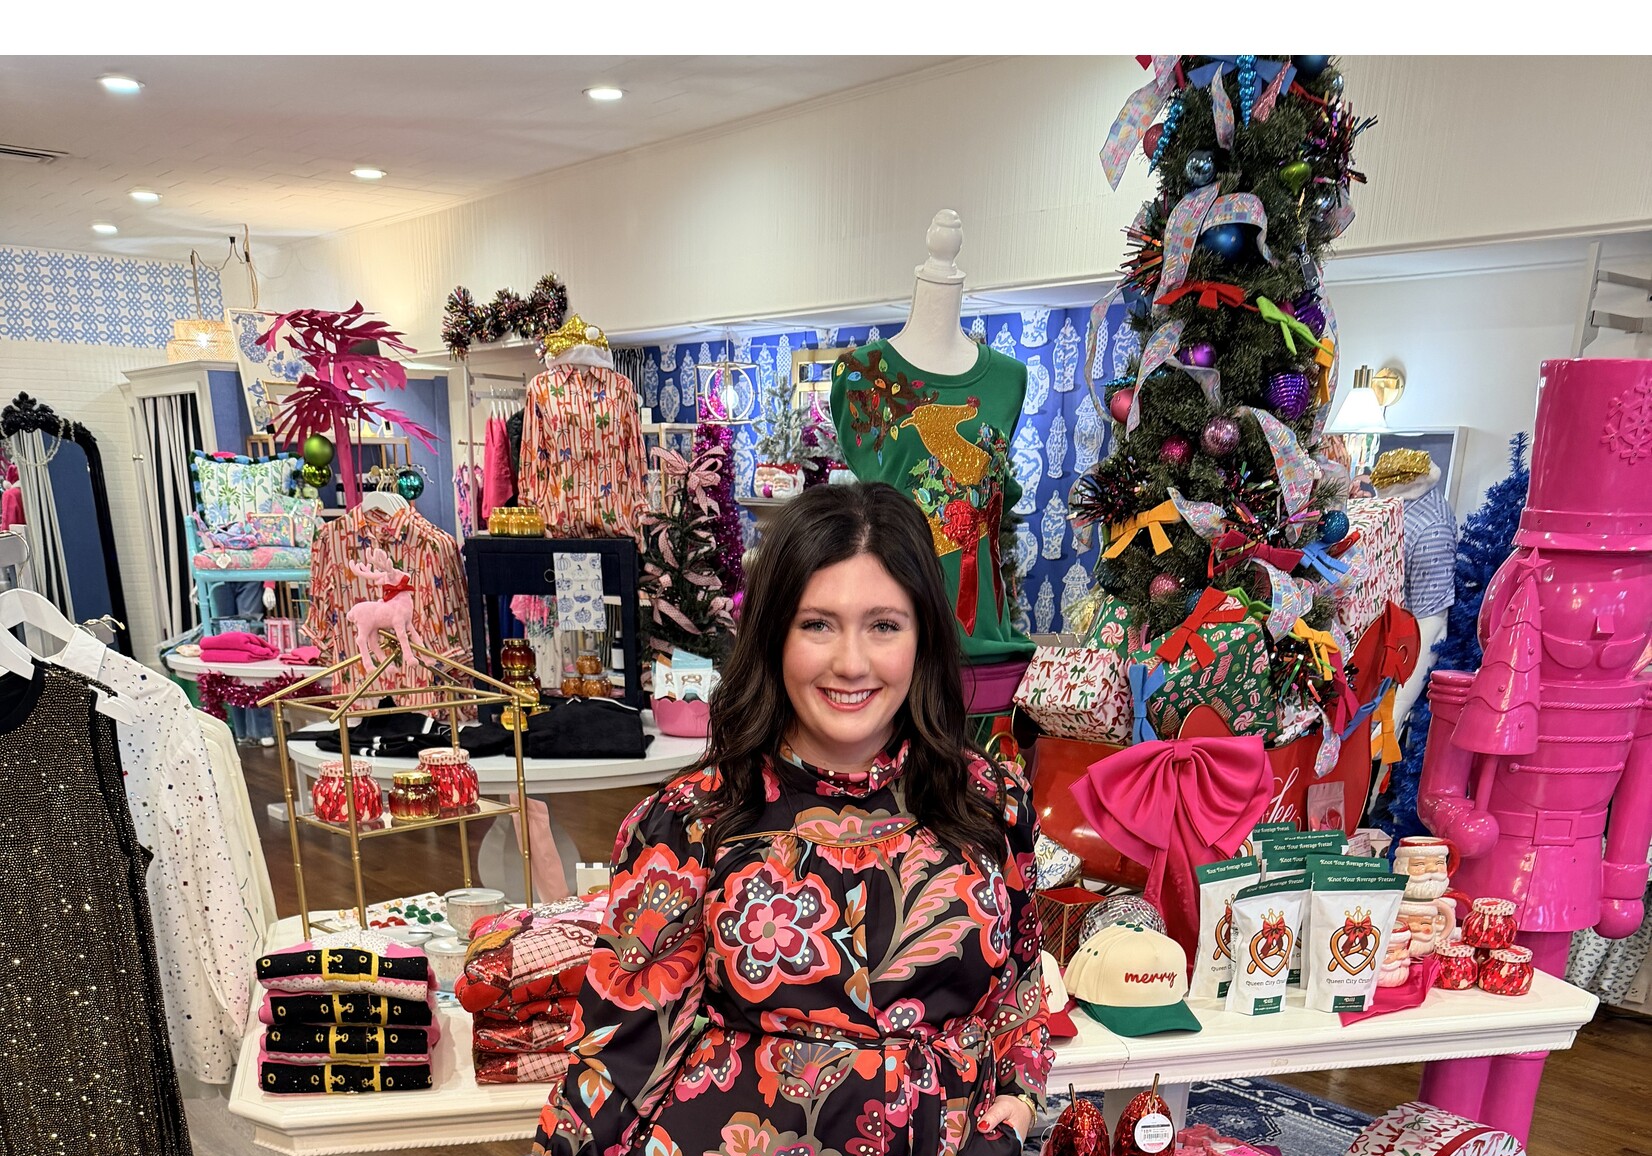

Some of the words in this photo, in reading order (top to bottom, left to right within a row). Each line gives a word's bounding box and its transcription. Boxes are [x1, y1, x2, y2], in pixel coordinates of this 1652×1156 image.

[1346, 860, 1364, 868] Average
[1287, 877, 1305, 885] Pretzel
[1124, 971, 1177, 988] merry
